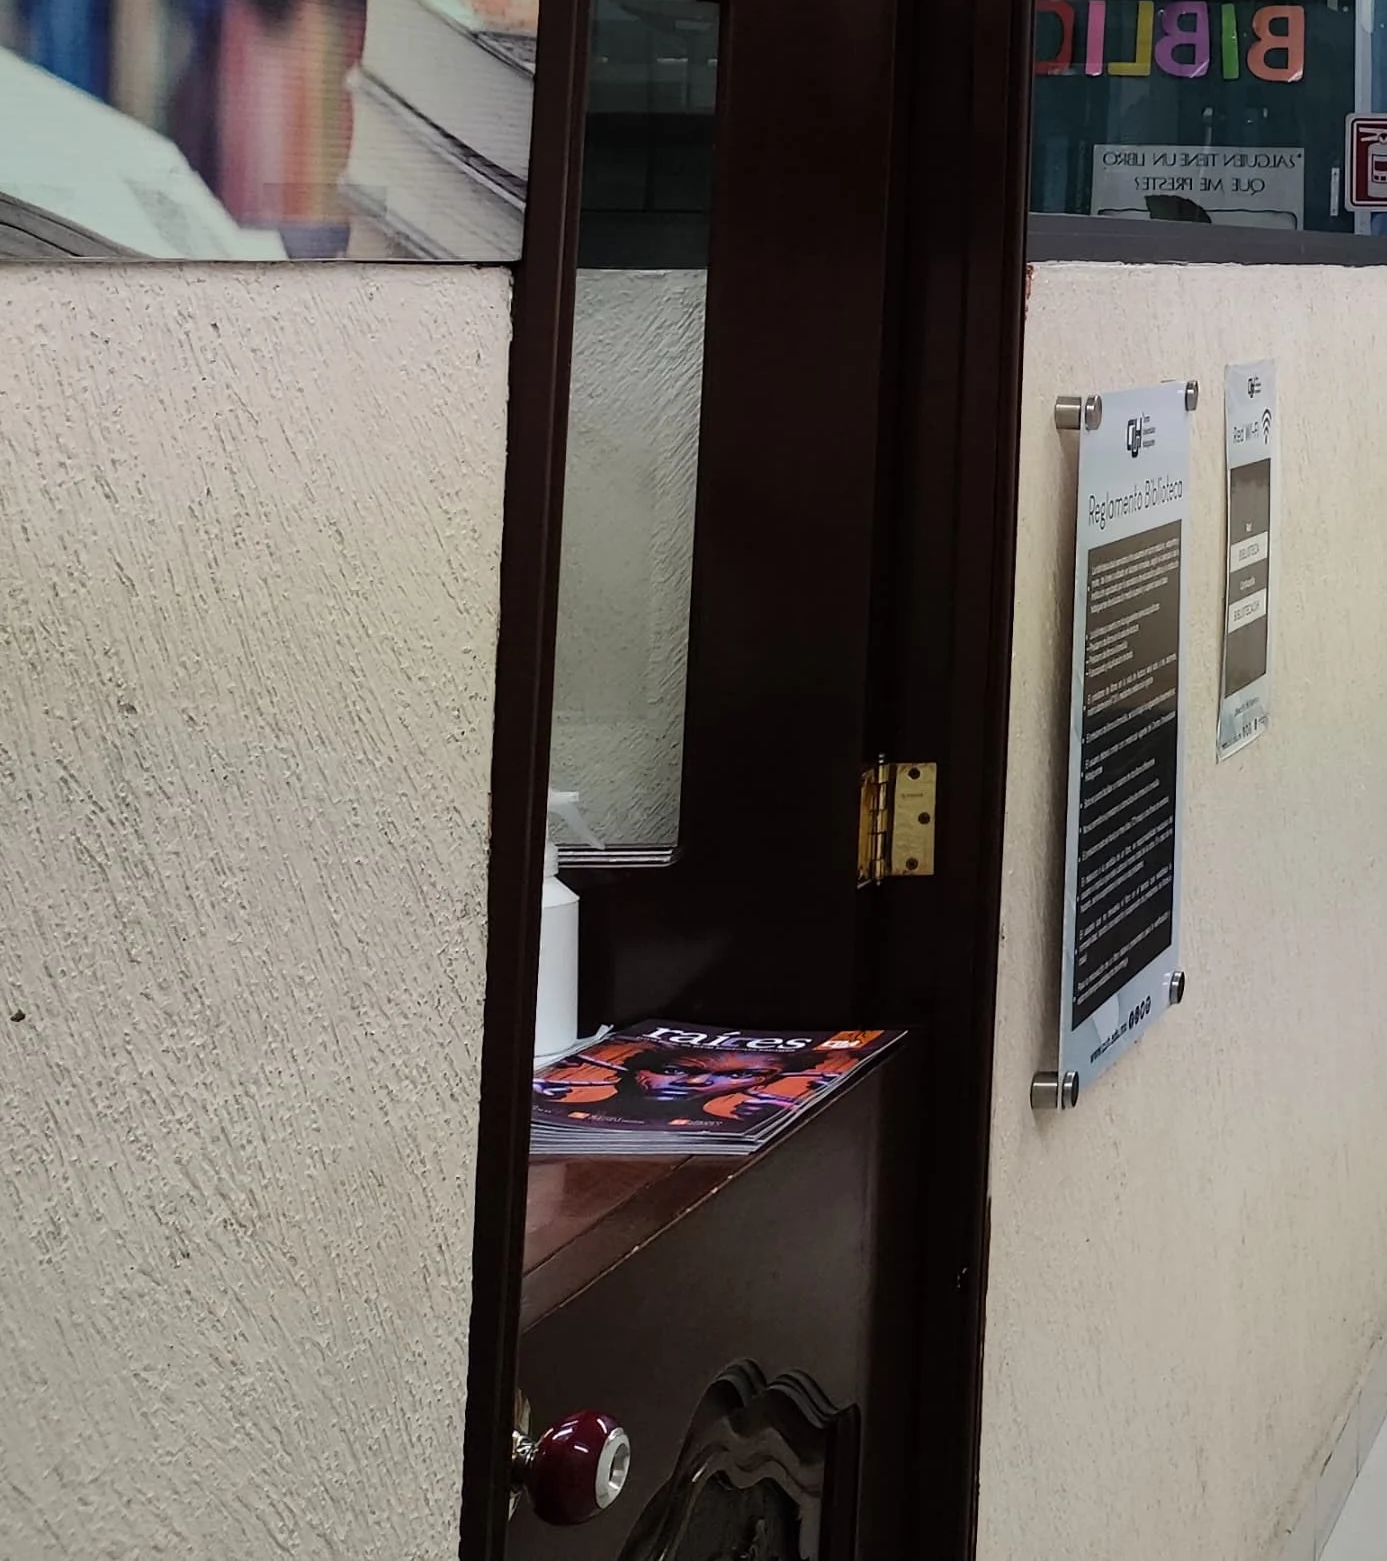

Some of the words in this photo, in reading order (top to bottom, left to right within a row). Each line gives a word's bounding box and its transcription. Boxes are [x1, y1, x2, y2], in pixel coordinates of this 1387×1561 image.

[1088, 483, 1143, 530] Reglamento
[1144, 474, 1183, 509] Biblioteca
[643, 1026, 814, 1050] raíces
